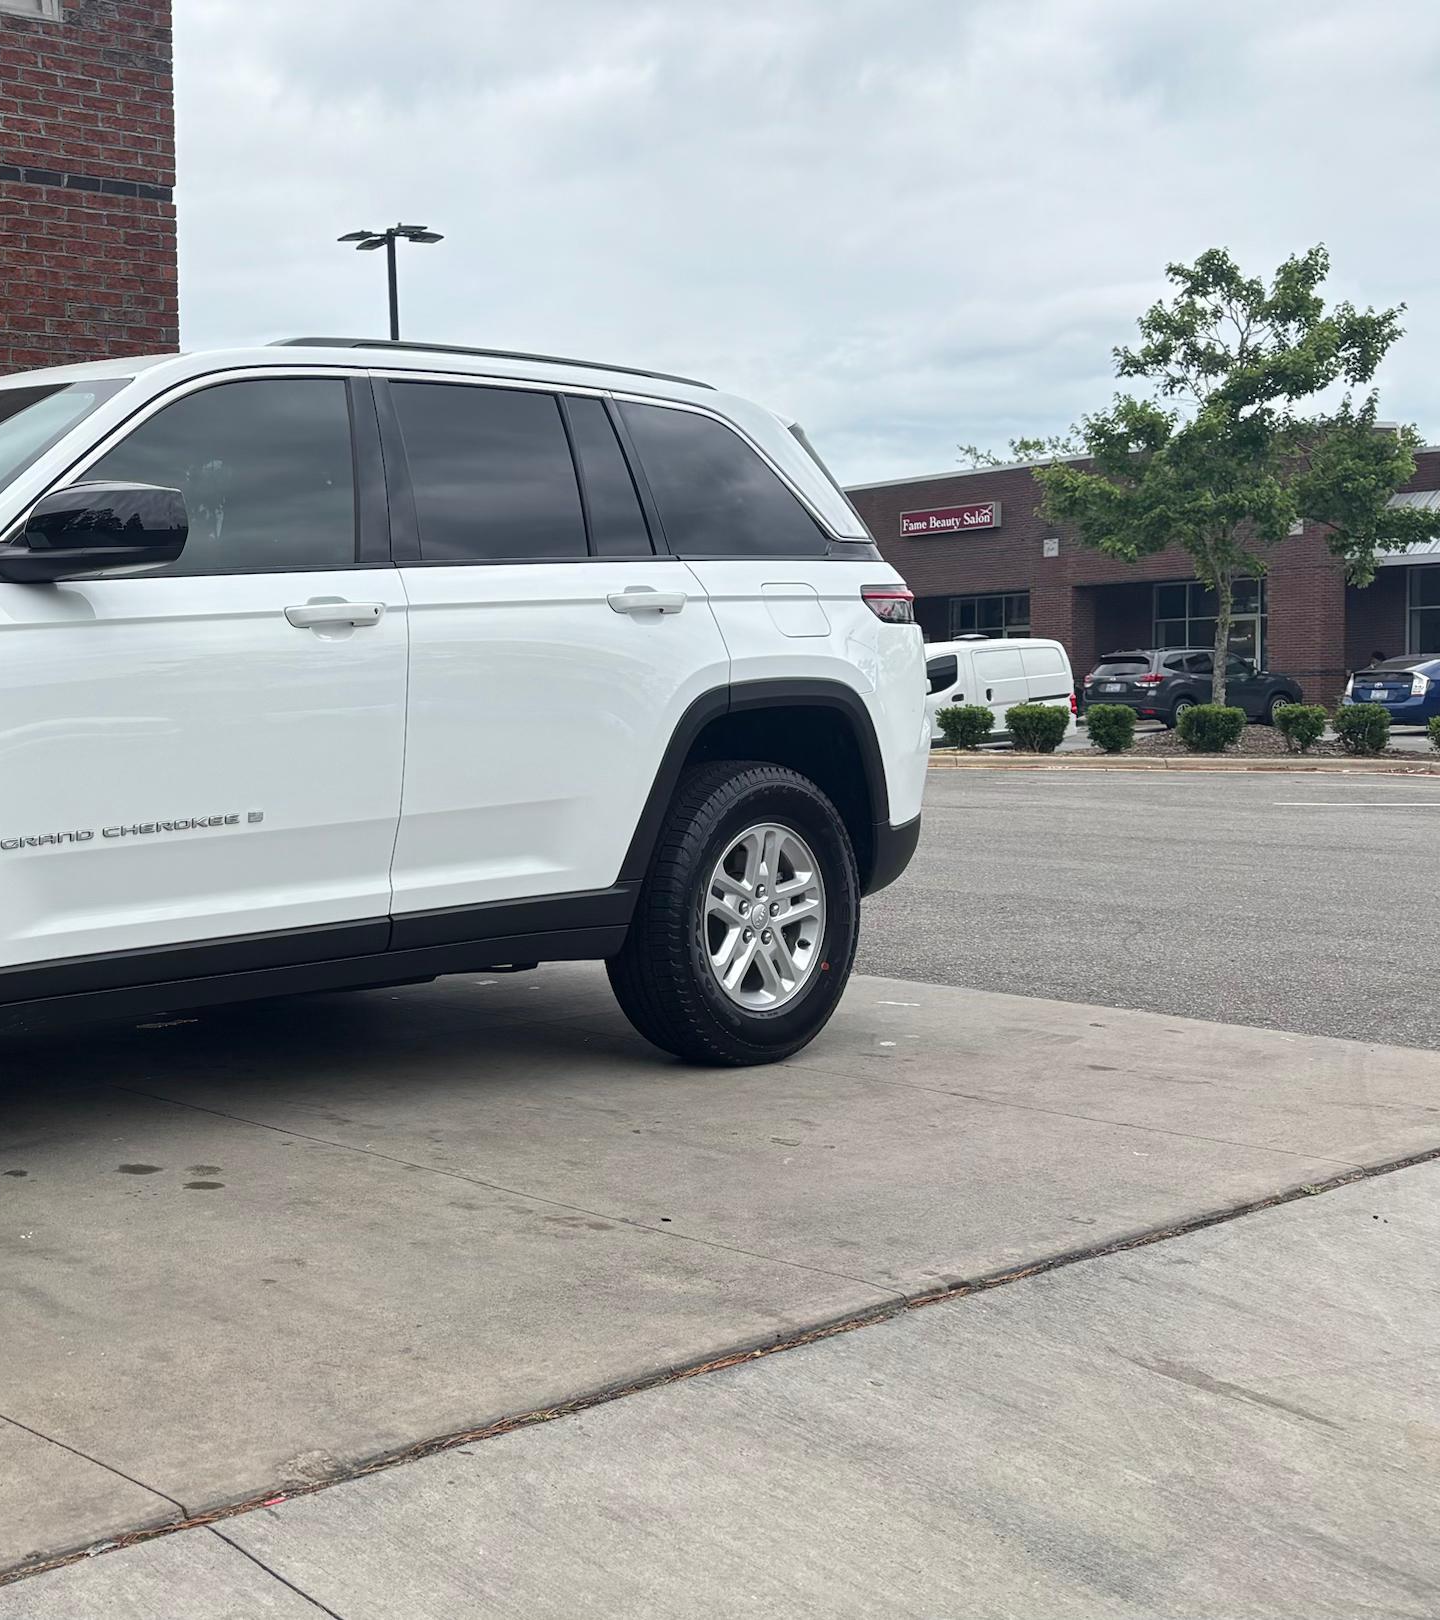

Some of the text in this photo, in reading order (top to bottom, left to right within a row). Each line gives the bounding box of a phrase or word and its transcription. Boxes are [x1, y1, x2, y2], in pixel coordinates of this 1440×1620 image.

[902, 511, 990, 532] Fame Beauty Salon
[0, 813, 241, 850] GRAND CHEROKEE
